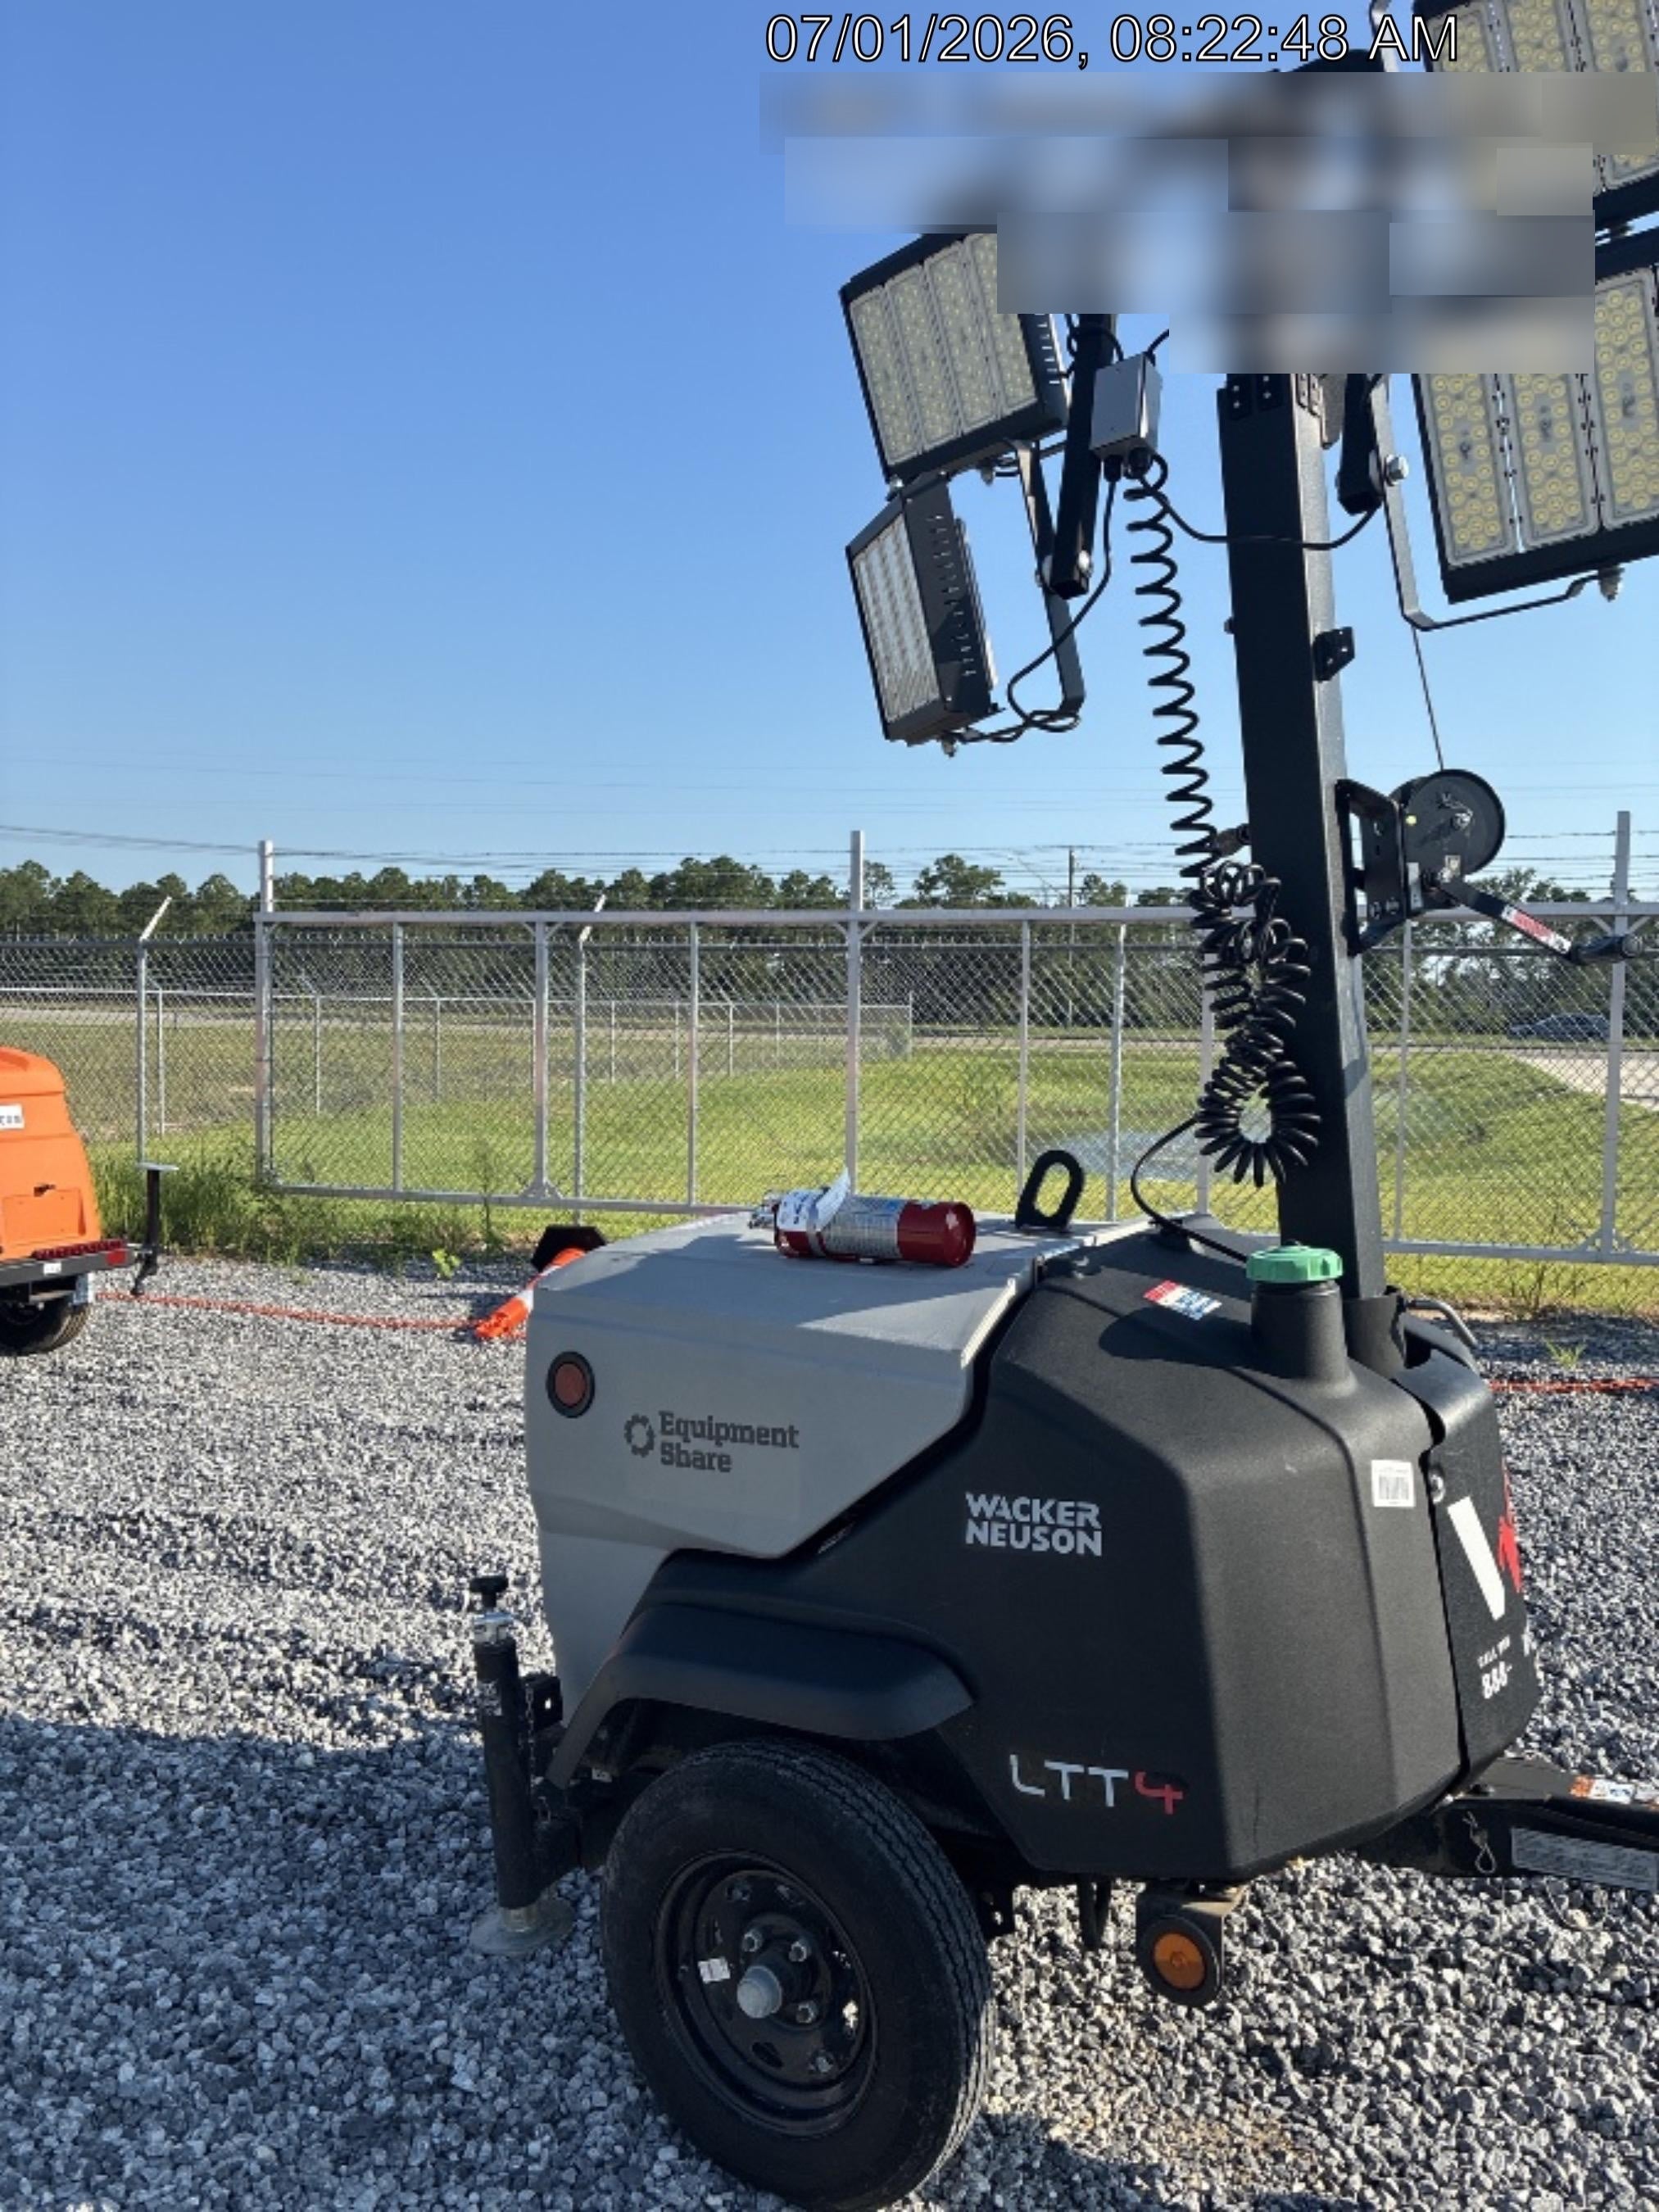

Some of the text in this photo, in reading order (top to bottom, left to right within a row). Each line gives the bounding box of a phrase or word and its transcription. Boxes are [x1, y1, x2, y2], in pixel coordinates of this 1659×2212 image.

[659, 1411, 800, 1448] Equipment
[660, 1440, 732, 1473] Share
[965, 1492, 1102, 1529] WACKER
[965, 1519, 1103, 1557] NEUSON
[1009, 1754, 1183, 1815] LTT4
